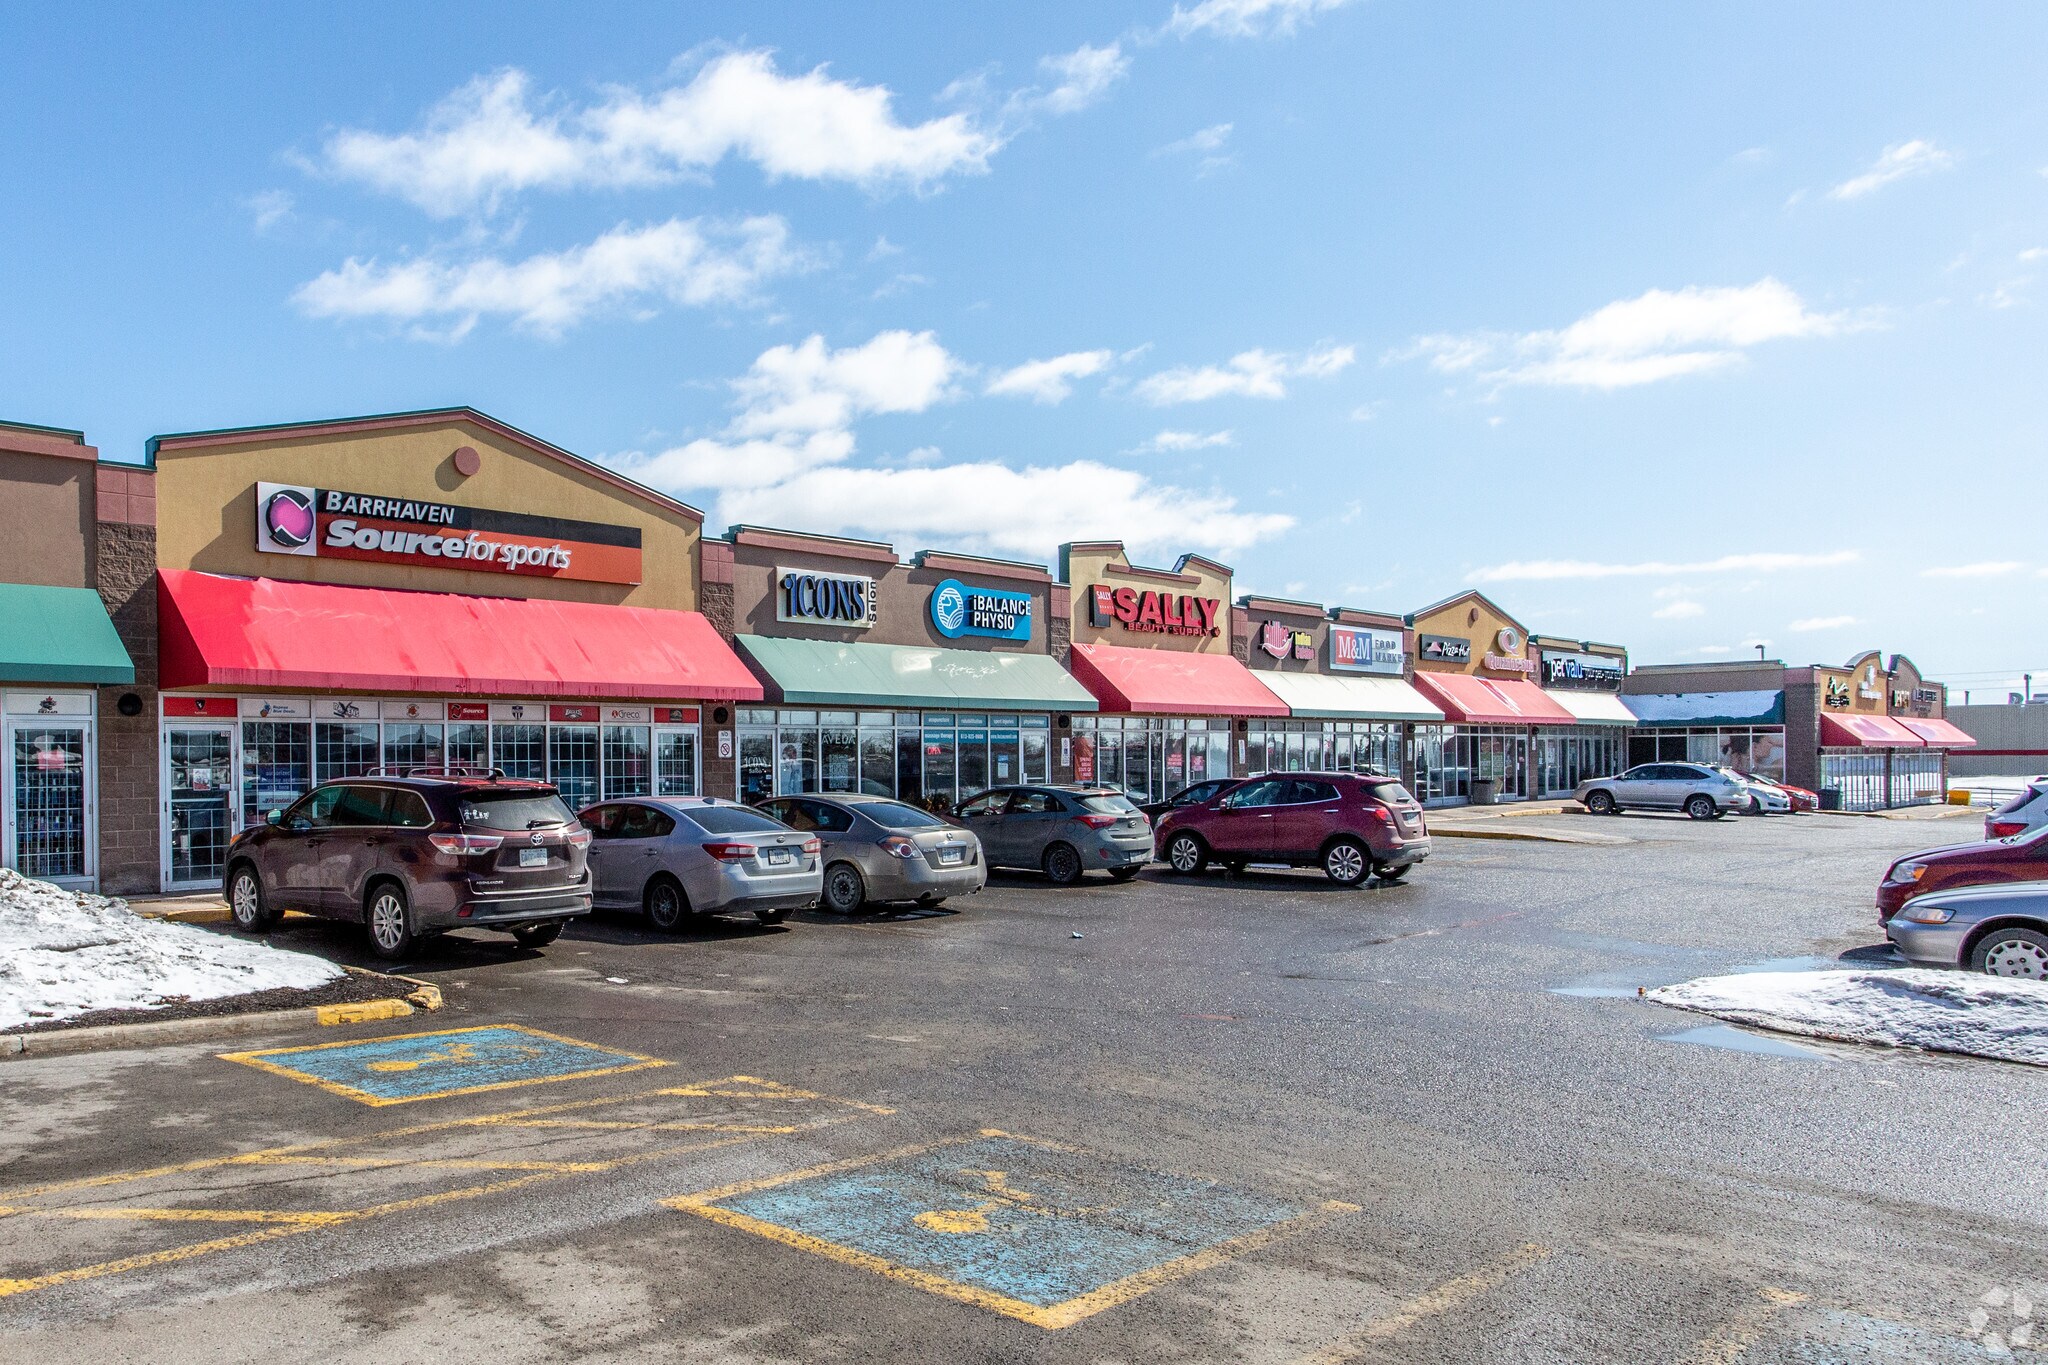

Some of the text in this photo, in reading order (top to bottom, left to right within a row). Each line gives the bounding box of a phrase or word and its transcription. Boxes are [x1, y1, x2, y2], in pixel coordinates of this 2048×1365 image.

[326, 491, 455, 524] BARRHAVEN
[868, 581, 877, 623] Salon
[1096, 590, 1111, 600] SALLY
[973, 594, 1032, 616] iBALANCE
[1115, 587, 1220, 628] SALLY
[973, 613, 1015, 631] PHYSIO
[1128, 623, 1210, 637] BEAUTY SUPPLY
[1338, 635, 1370, 660] M&M
[1375, 639, 1396, 649] FOOD
[1441, 642, 1471, 657] Pizza Hut
[1375, 652, 1407, 664] MARKET
[1551, 659, 1583, 681] pet valu
[619, 710, 640, 719] Greco
[822, 733, 856, 745] AVEDA
